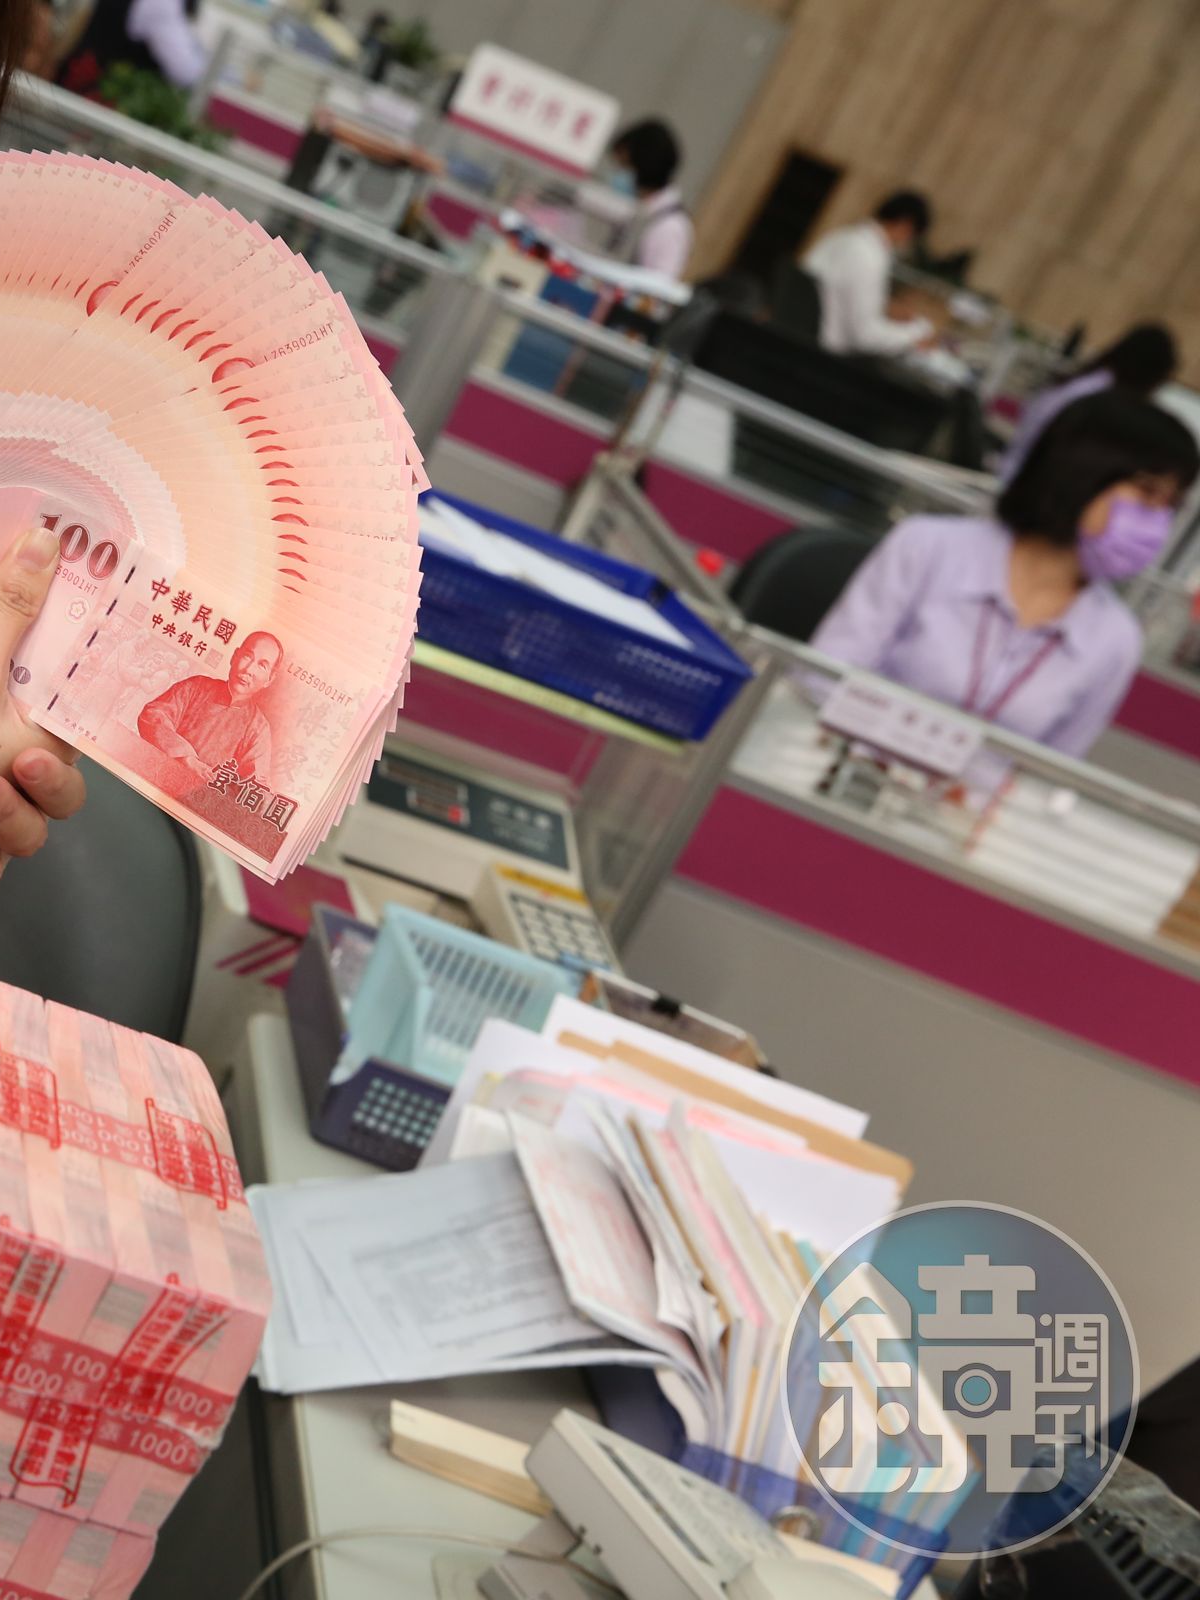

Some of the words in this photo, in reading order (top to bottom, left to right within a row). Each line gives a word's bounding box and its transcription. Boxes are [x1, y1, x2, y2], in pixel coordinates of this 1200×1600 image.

[150, 577, 237, 645] 中華民國
[151, 613, 208, 657] 中央銀行
[287, 662, 353, 707] LZ639001HT
[206, 757, 300, 833] 壹佰圓
[2, 1358, 64, 1394] 1000
[152, 1383, 213, 1418] 1000
[129, 1429, 189, 1466] 1000
